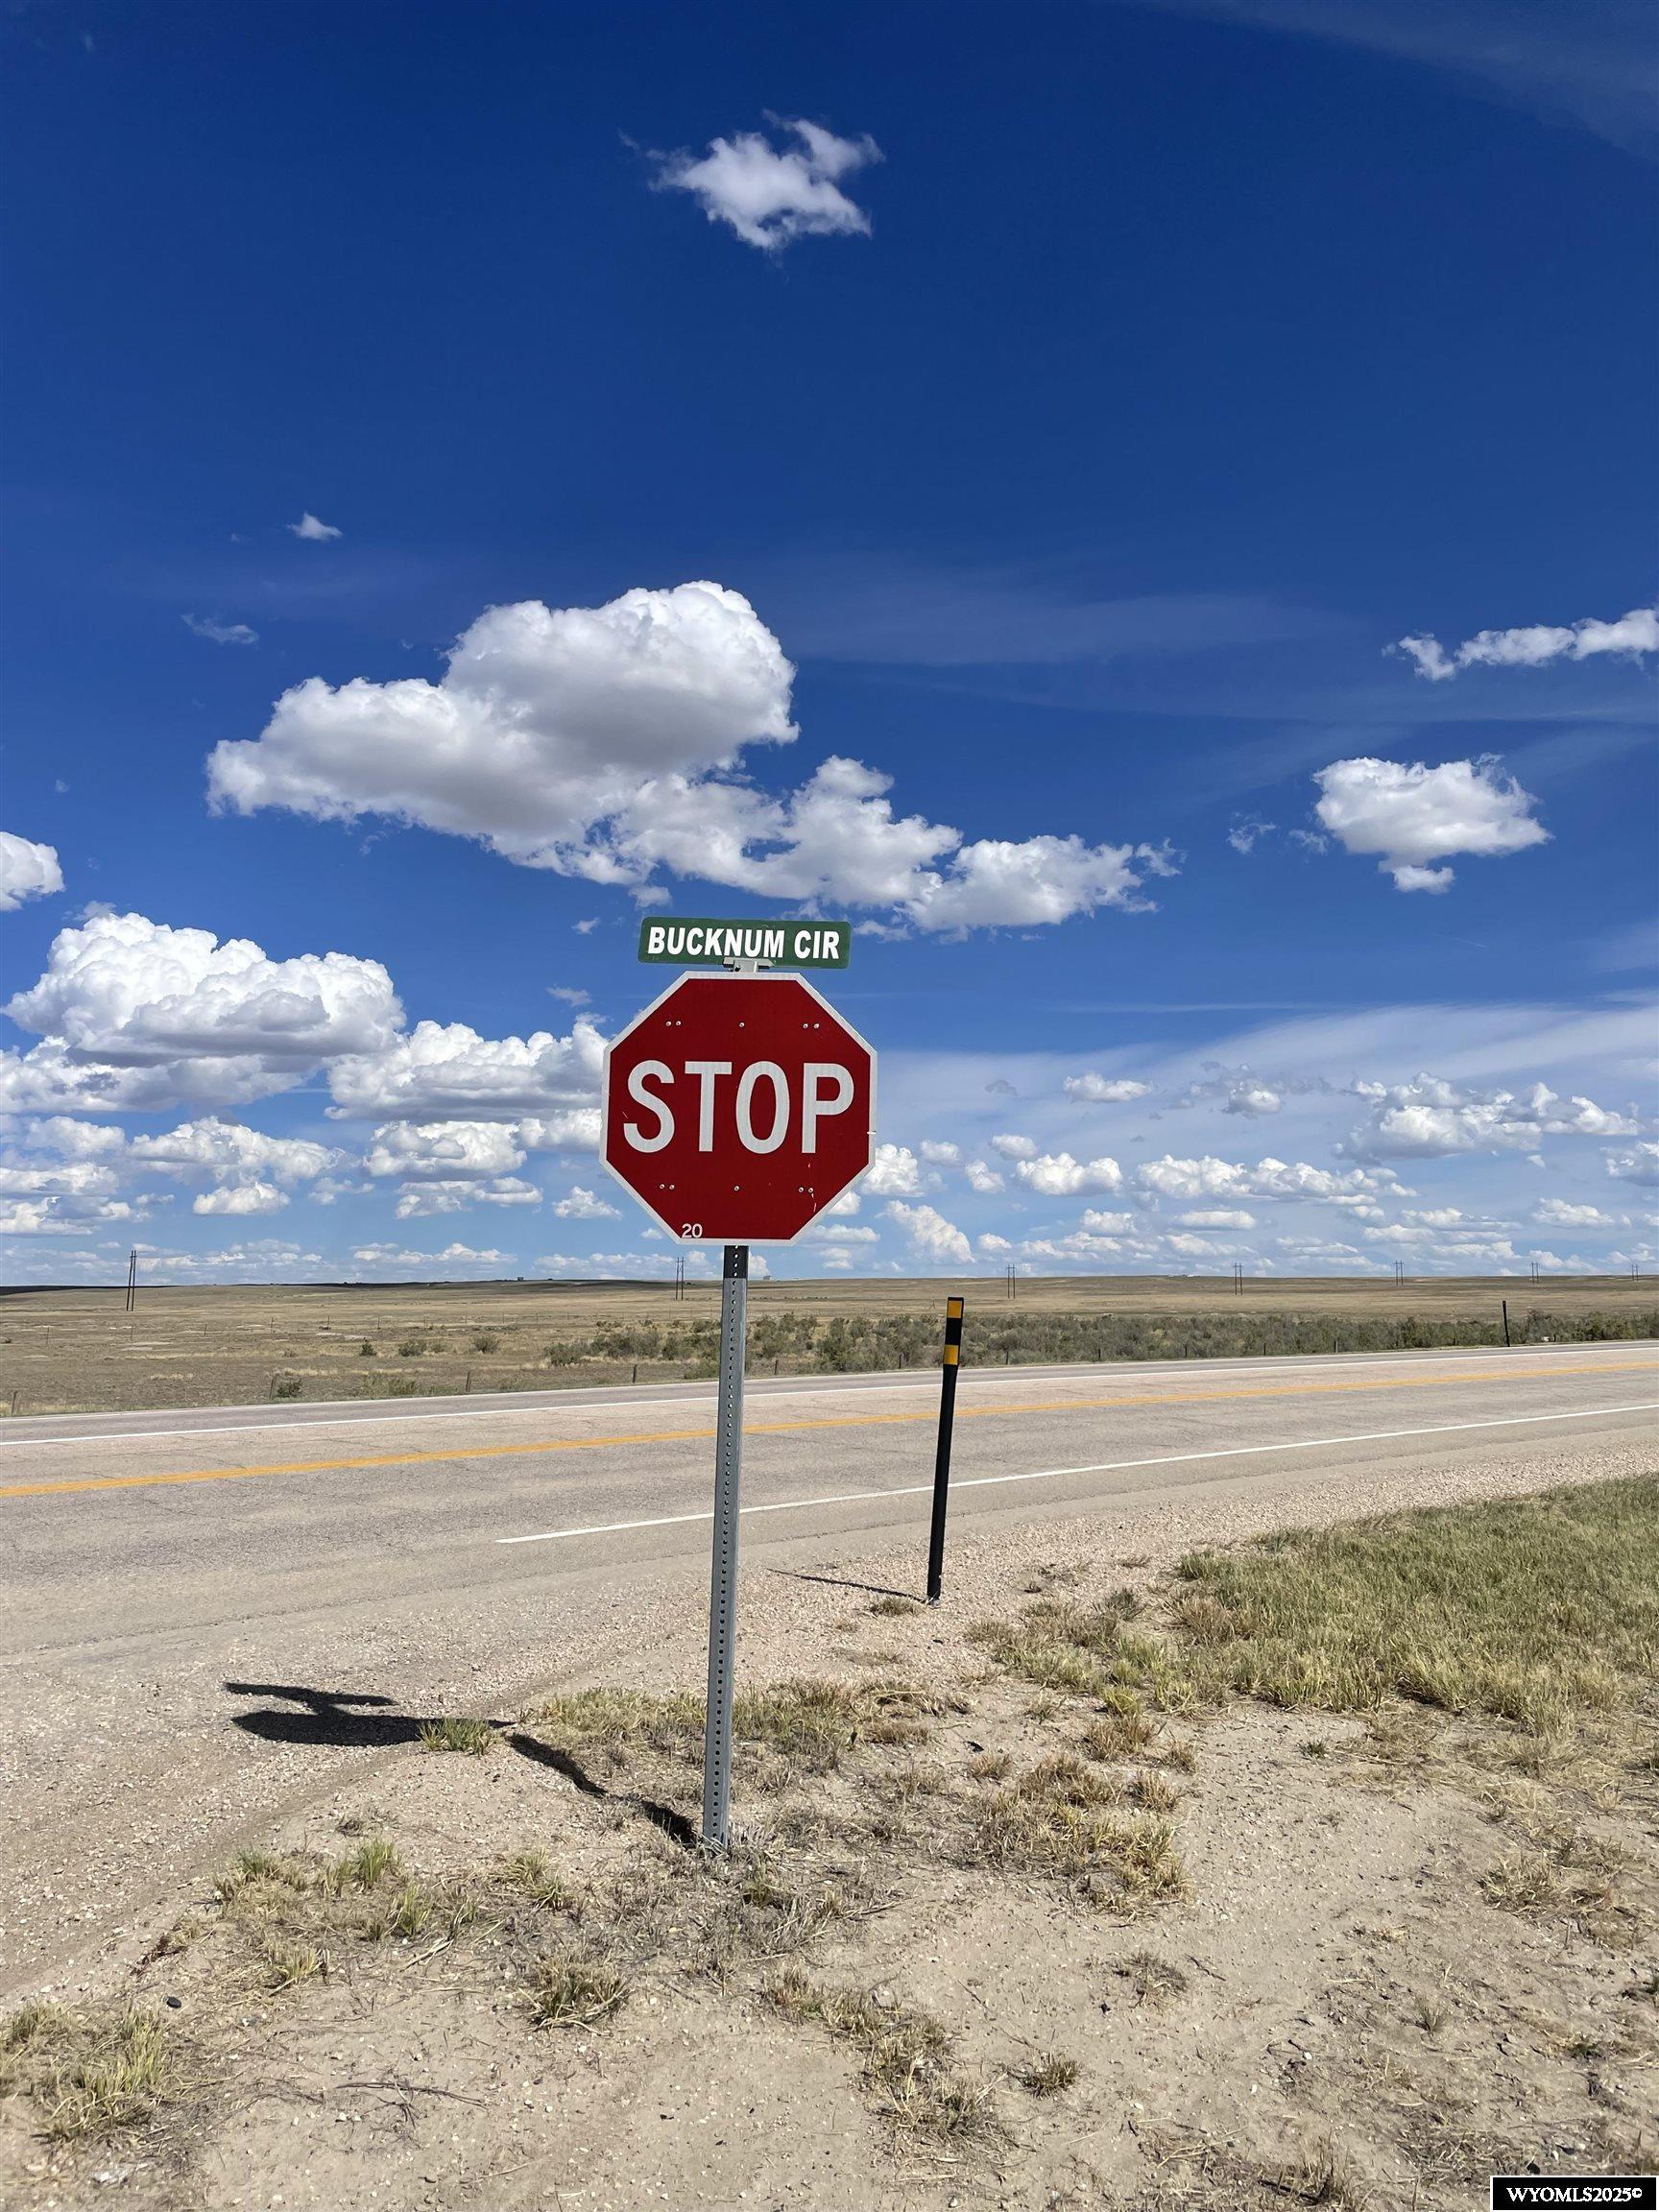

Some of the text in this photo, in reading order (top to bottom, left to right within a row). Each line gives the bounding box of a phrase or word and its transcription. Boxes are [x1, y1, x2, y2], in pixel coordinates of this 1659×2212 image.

[648, 926, 840, 959] BUCKNUM CIR
[623, 1060, 854, 1153] STOP
[682, 1223, 703, 1238] 20
